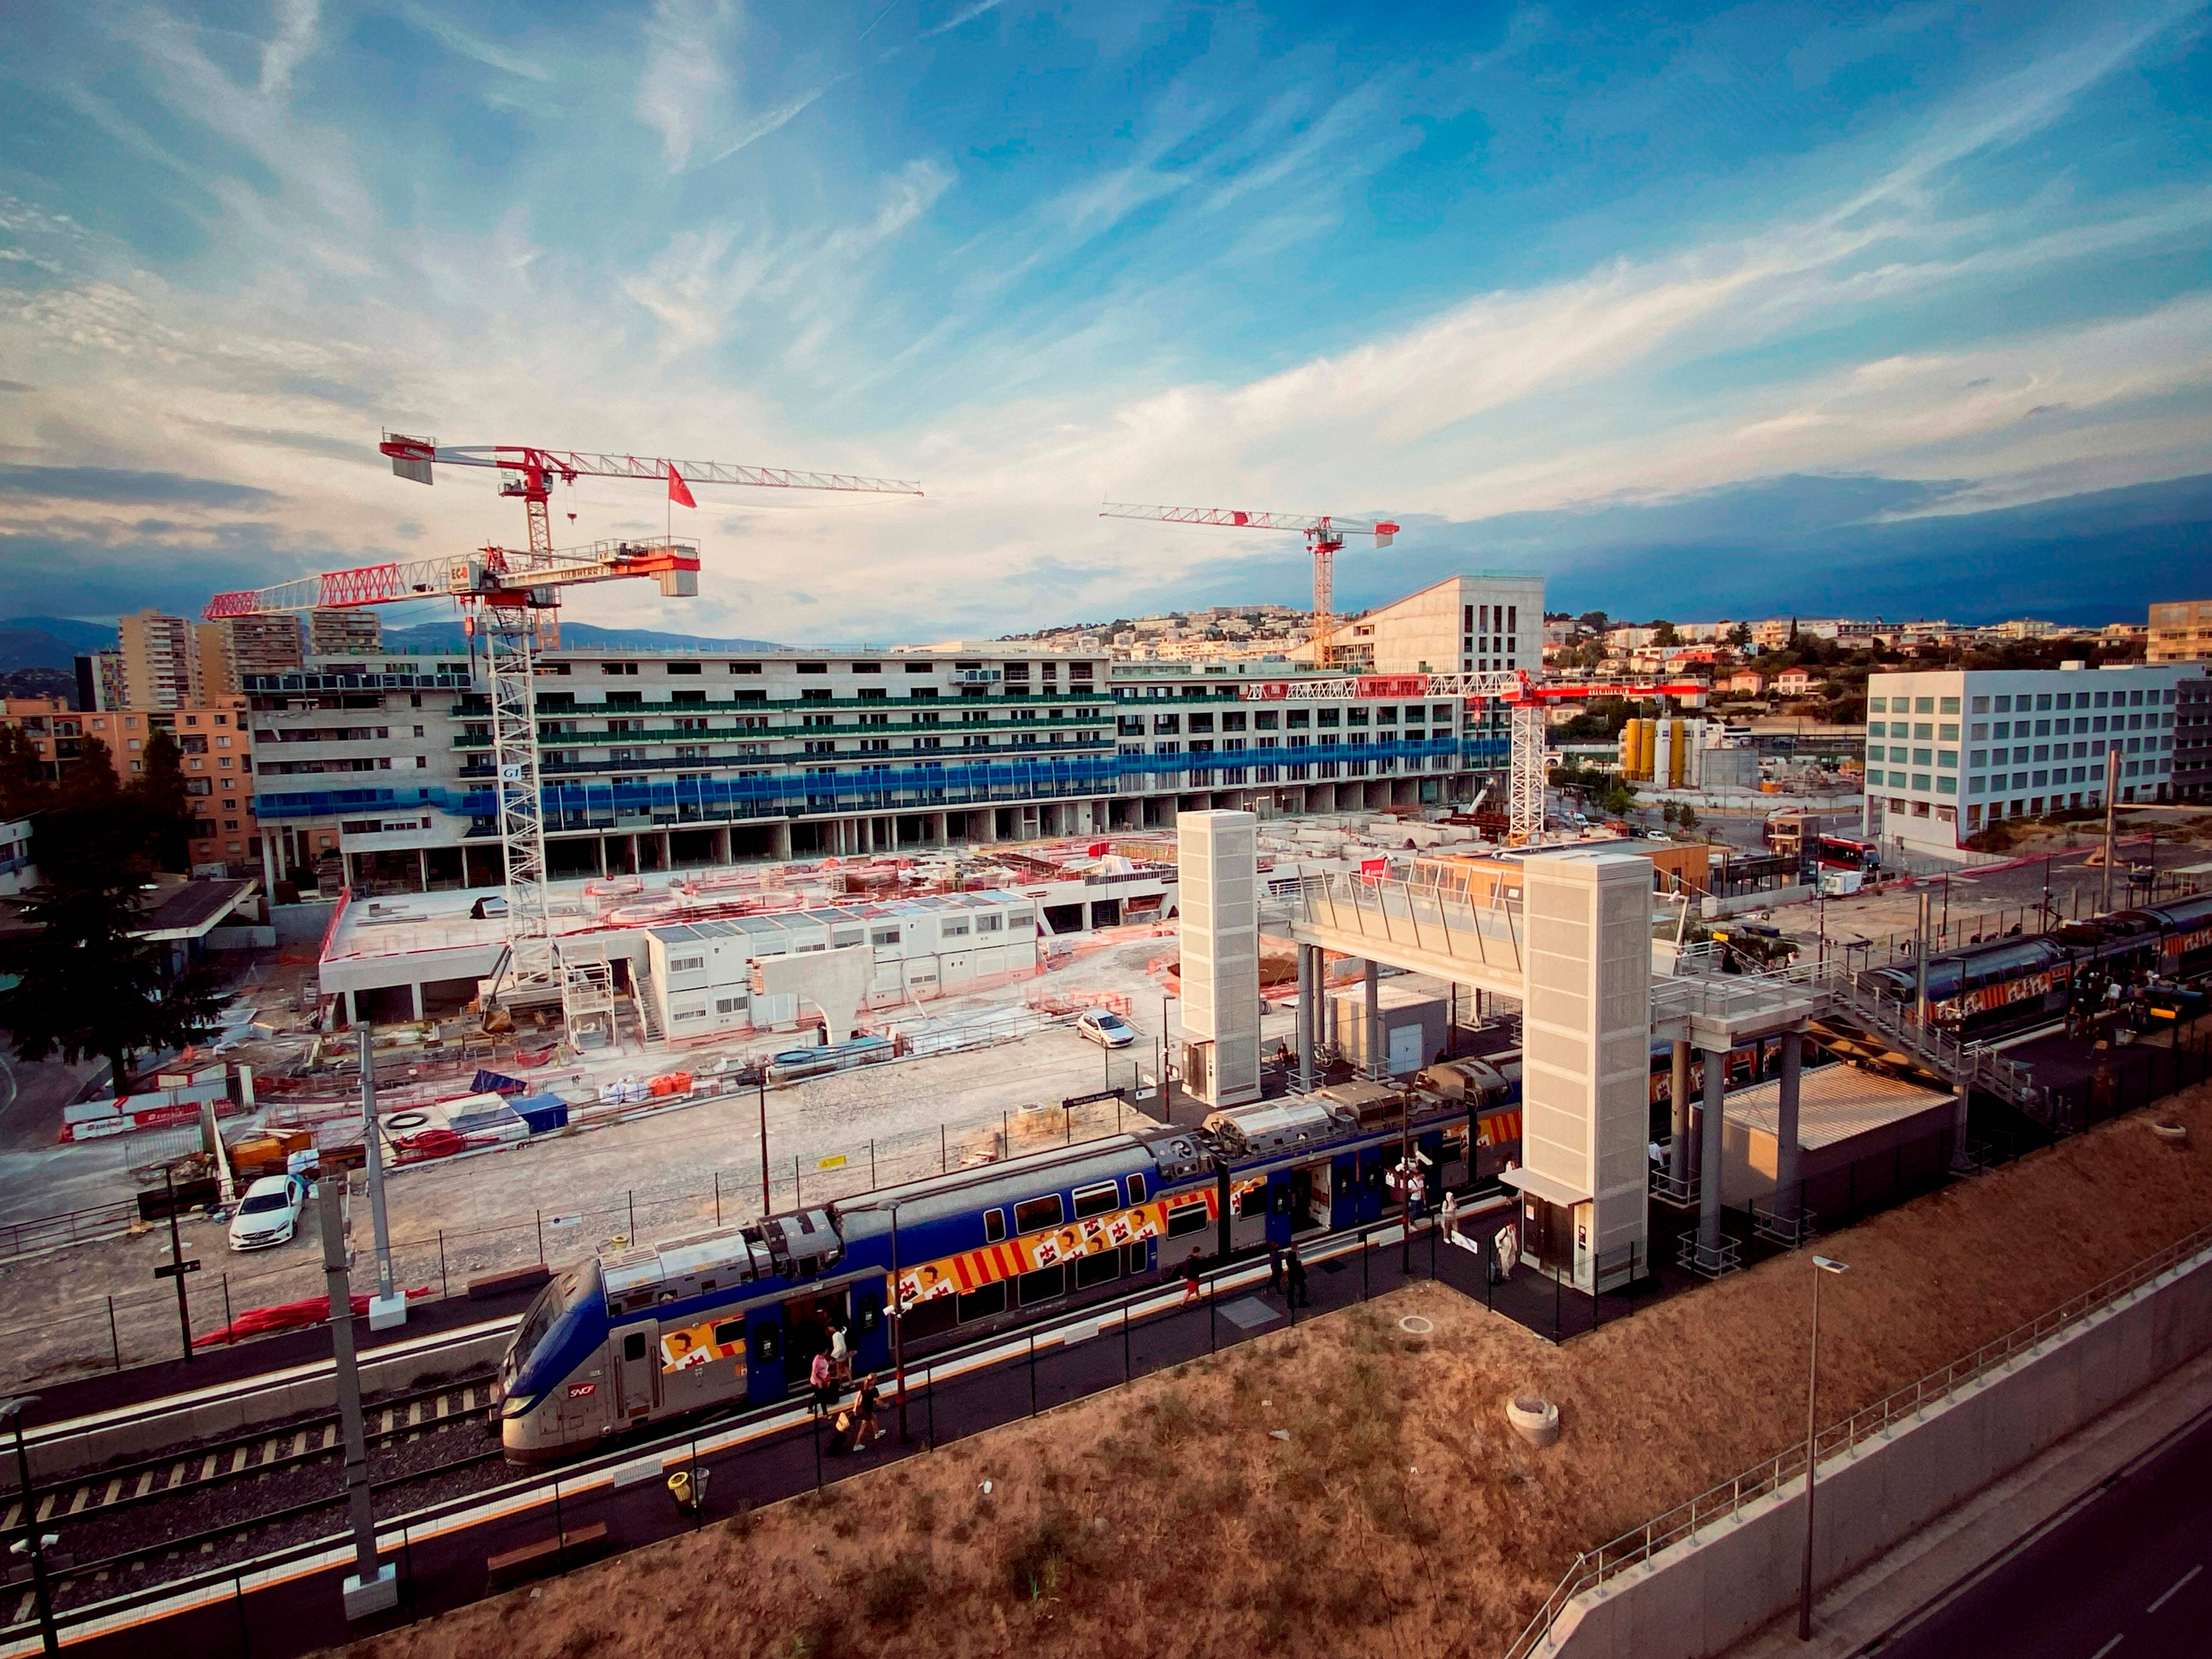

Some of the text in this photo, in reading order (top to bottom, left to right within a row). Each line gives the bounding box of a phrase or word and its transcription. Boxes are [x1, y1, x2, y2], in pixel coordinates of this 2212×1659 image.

[561, 567, 598, 579] LIEBHERR
[504, 768, 519, 777] G1
[570, 1385, 594, 1397] SNCF
